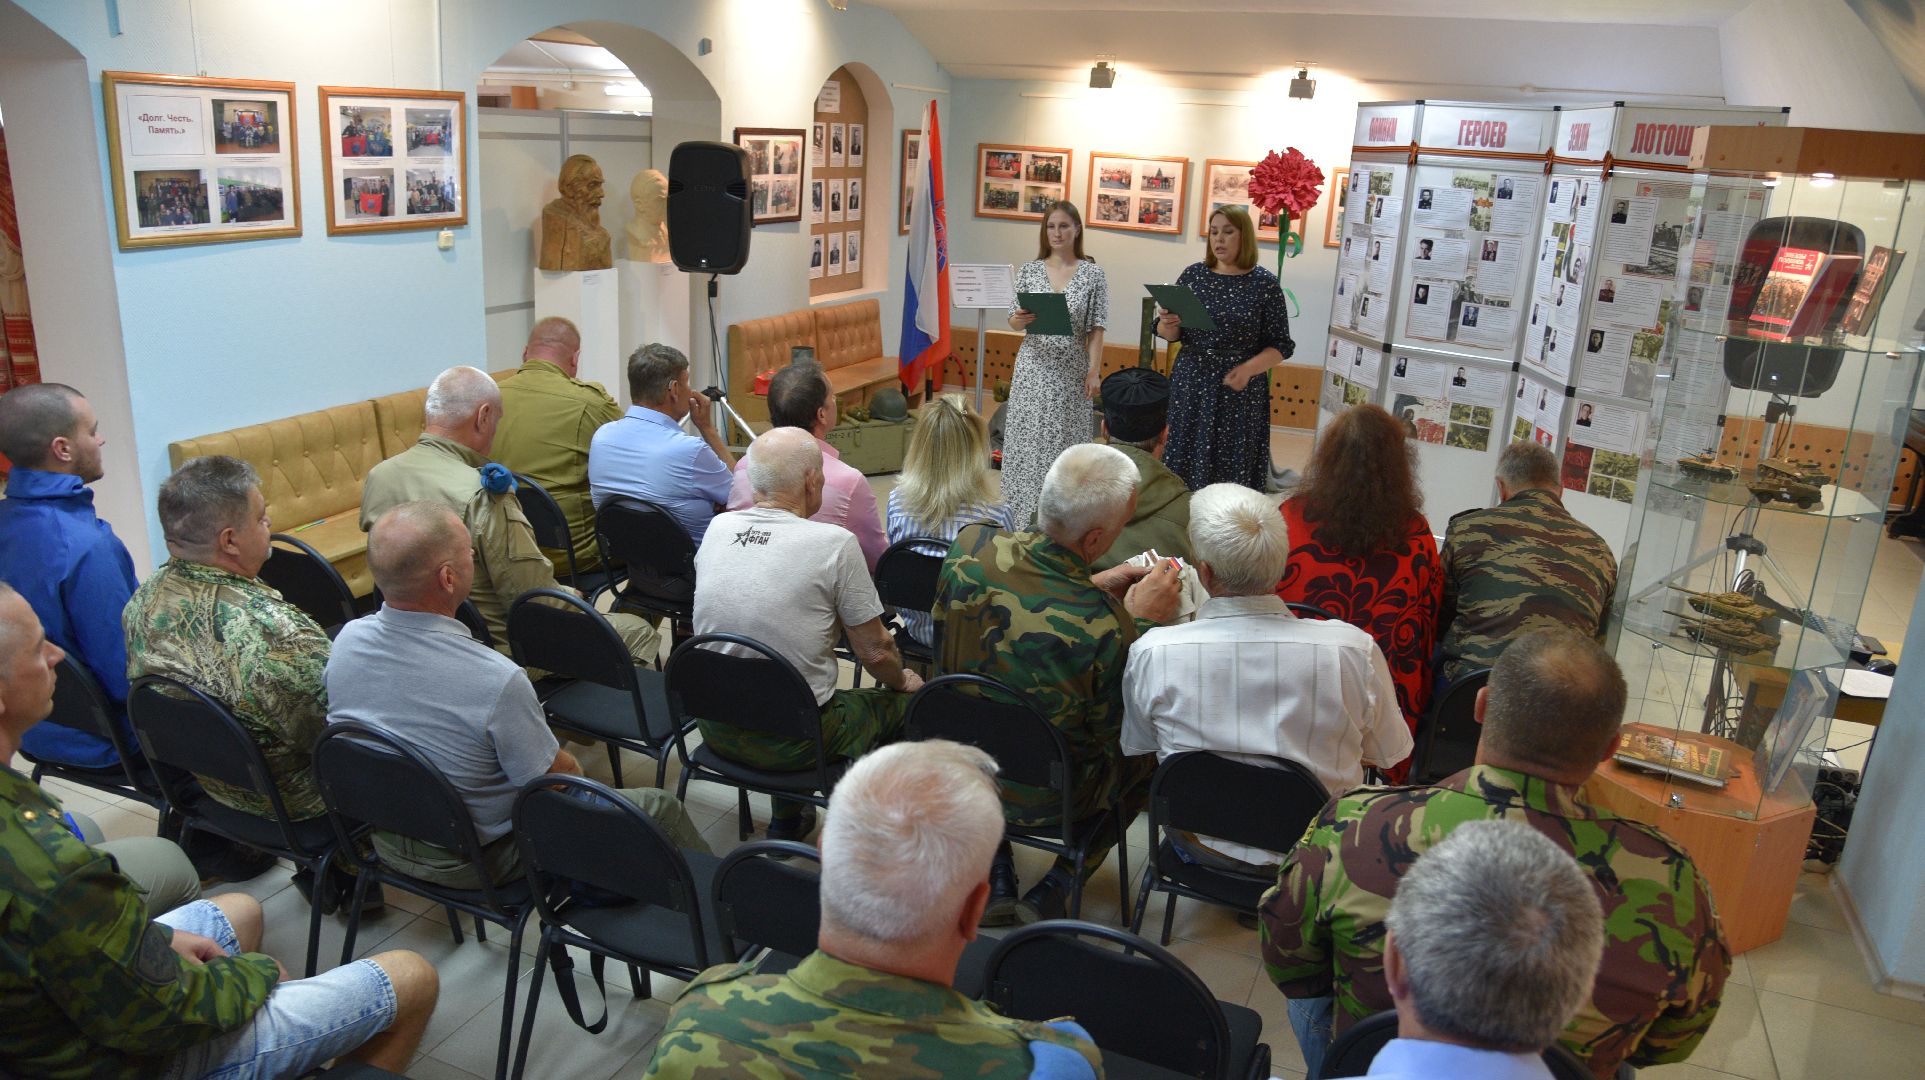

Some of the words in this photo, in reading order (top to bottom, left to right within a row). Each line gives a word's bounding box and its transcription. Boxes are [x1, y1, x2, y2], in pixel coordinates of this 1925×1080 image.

[138, 113, 165, 122] «Долг.
[167, 114, 194, 122] Честь.
[1457, 119, 1508, 148] ГЕРОЕВ
[1630, 122, 1695, 156] ЛОТОШ
